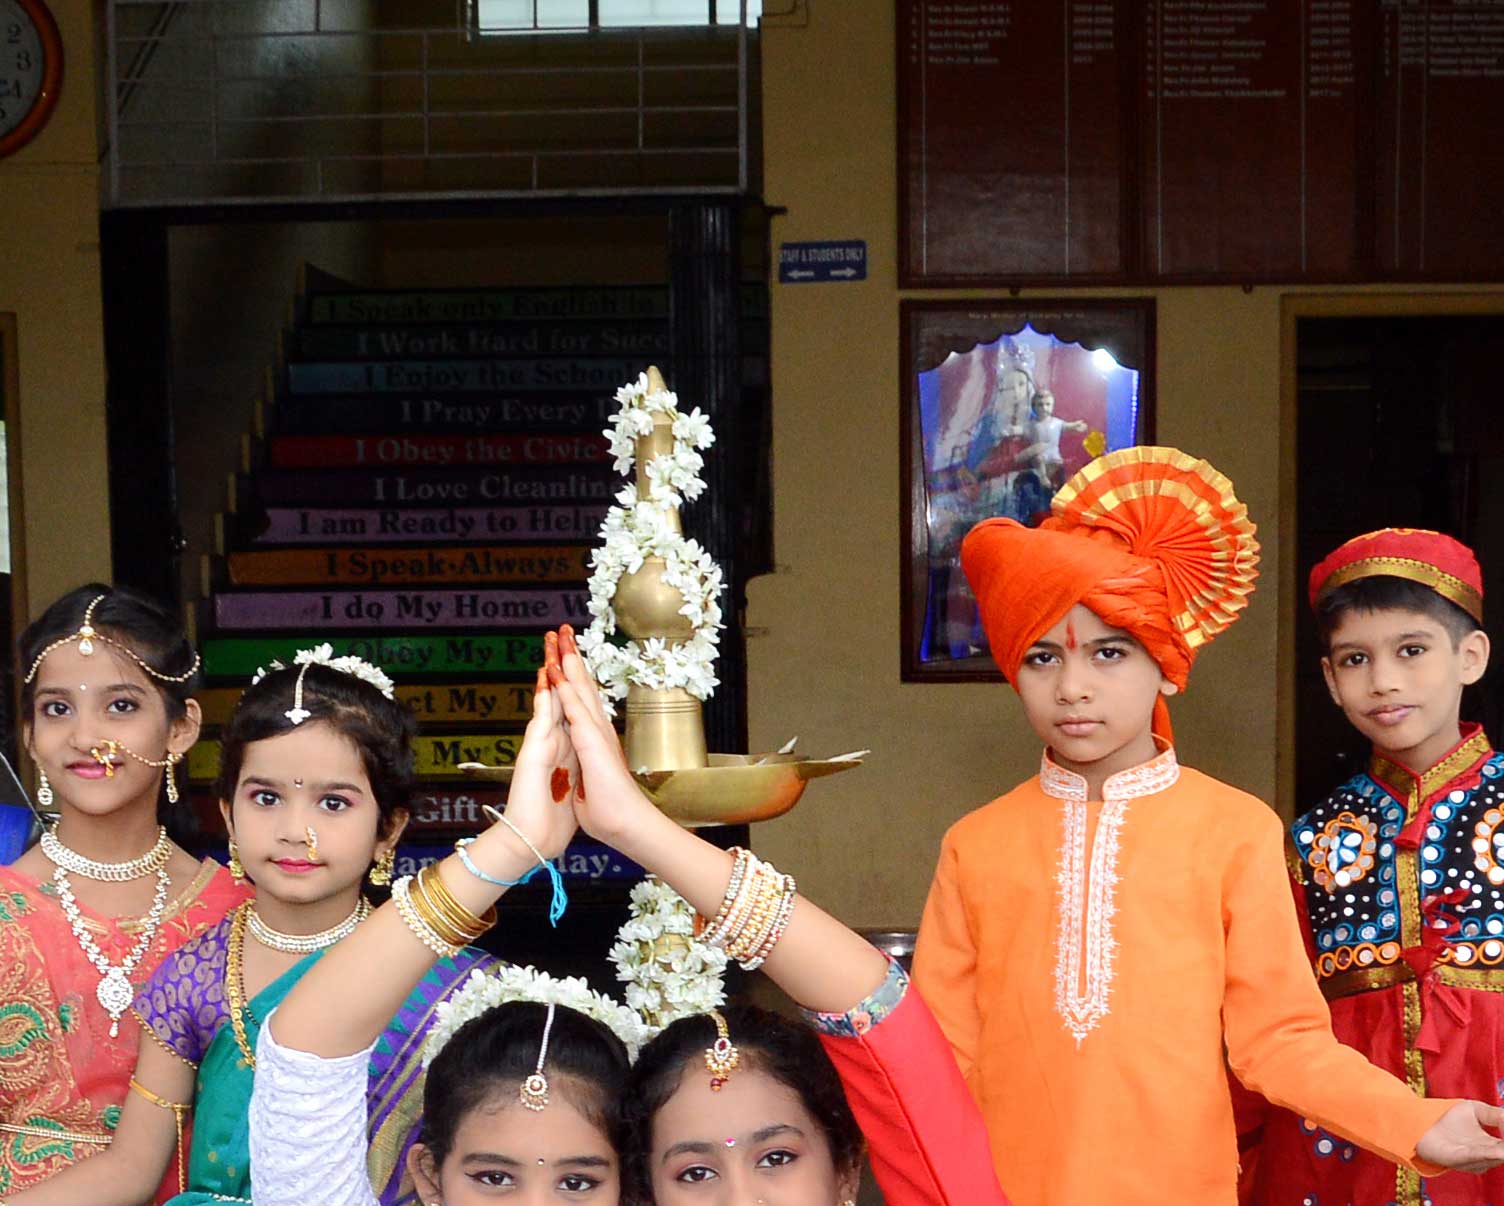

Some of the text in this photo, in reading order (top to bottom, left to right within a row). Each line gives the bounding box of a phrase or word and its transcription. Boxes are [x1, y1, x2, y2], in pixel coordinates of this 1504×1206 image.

[421, 400, 491, 430] Pray
[501, 400, 586, 428] Every
[376, 440, 456, 469] Obey
[465, 439, 512, 463] the
[398, 477, 468, 501] Love
[299, 512, 310, 535] I
[321, 517, 366, 535] am
[378, 511, 476, 540] Ready
[488, 512, 517, 533] to
[327, 553, 337, 576] I
[321, 596, 333, 619] I
[345, 596, 384, 618] do
[396, 596, 443, 623] My
[455, 594, 549, 619] Home
[446, 639, 498, 667] My
[447, 688, 498, 715] My
[431, 741, 484, 767] My
